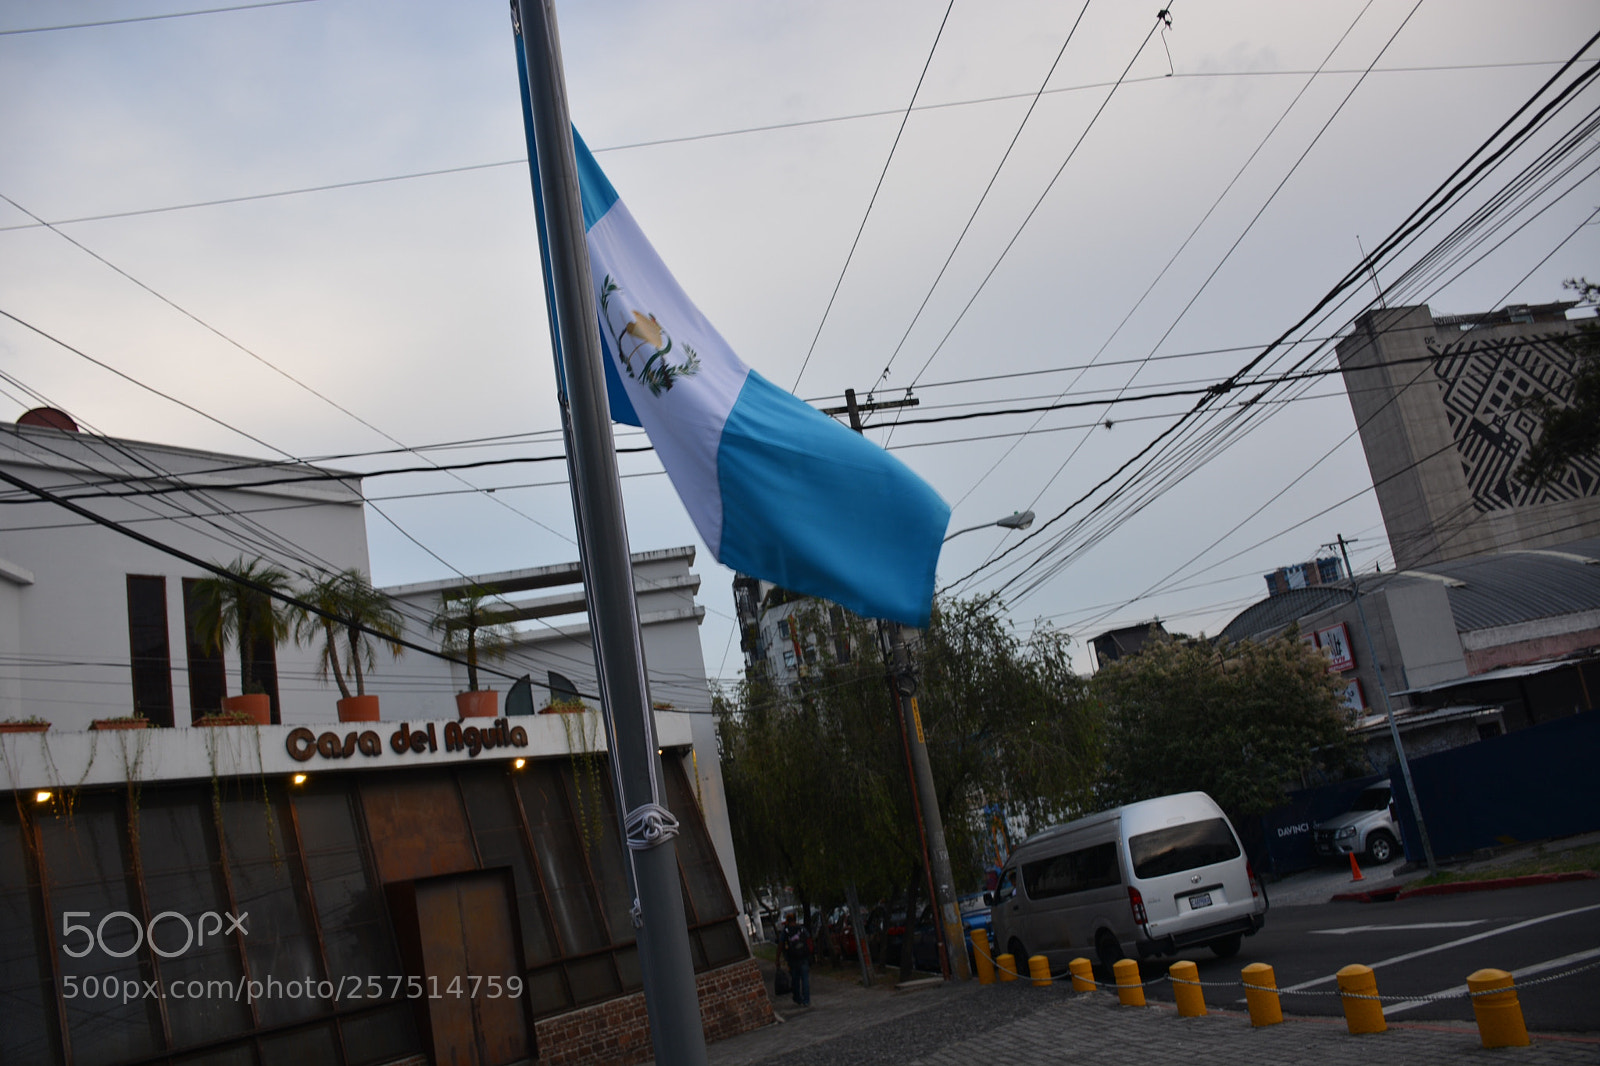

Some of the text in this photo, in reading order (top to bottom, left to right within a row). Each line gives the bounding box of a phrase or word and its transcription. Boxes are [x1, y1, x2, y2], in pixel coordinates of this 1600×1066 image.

[286, 727, 382, 762] Casa
[390, 722, 438, 754] del
[1278, 823, 1309, 837] DAVINCI
